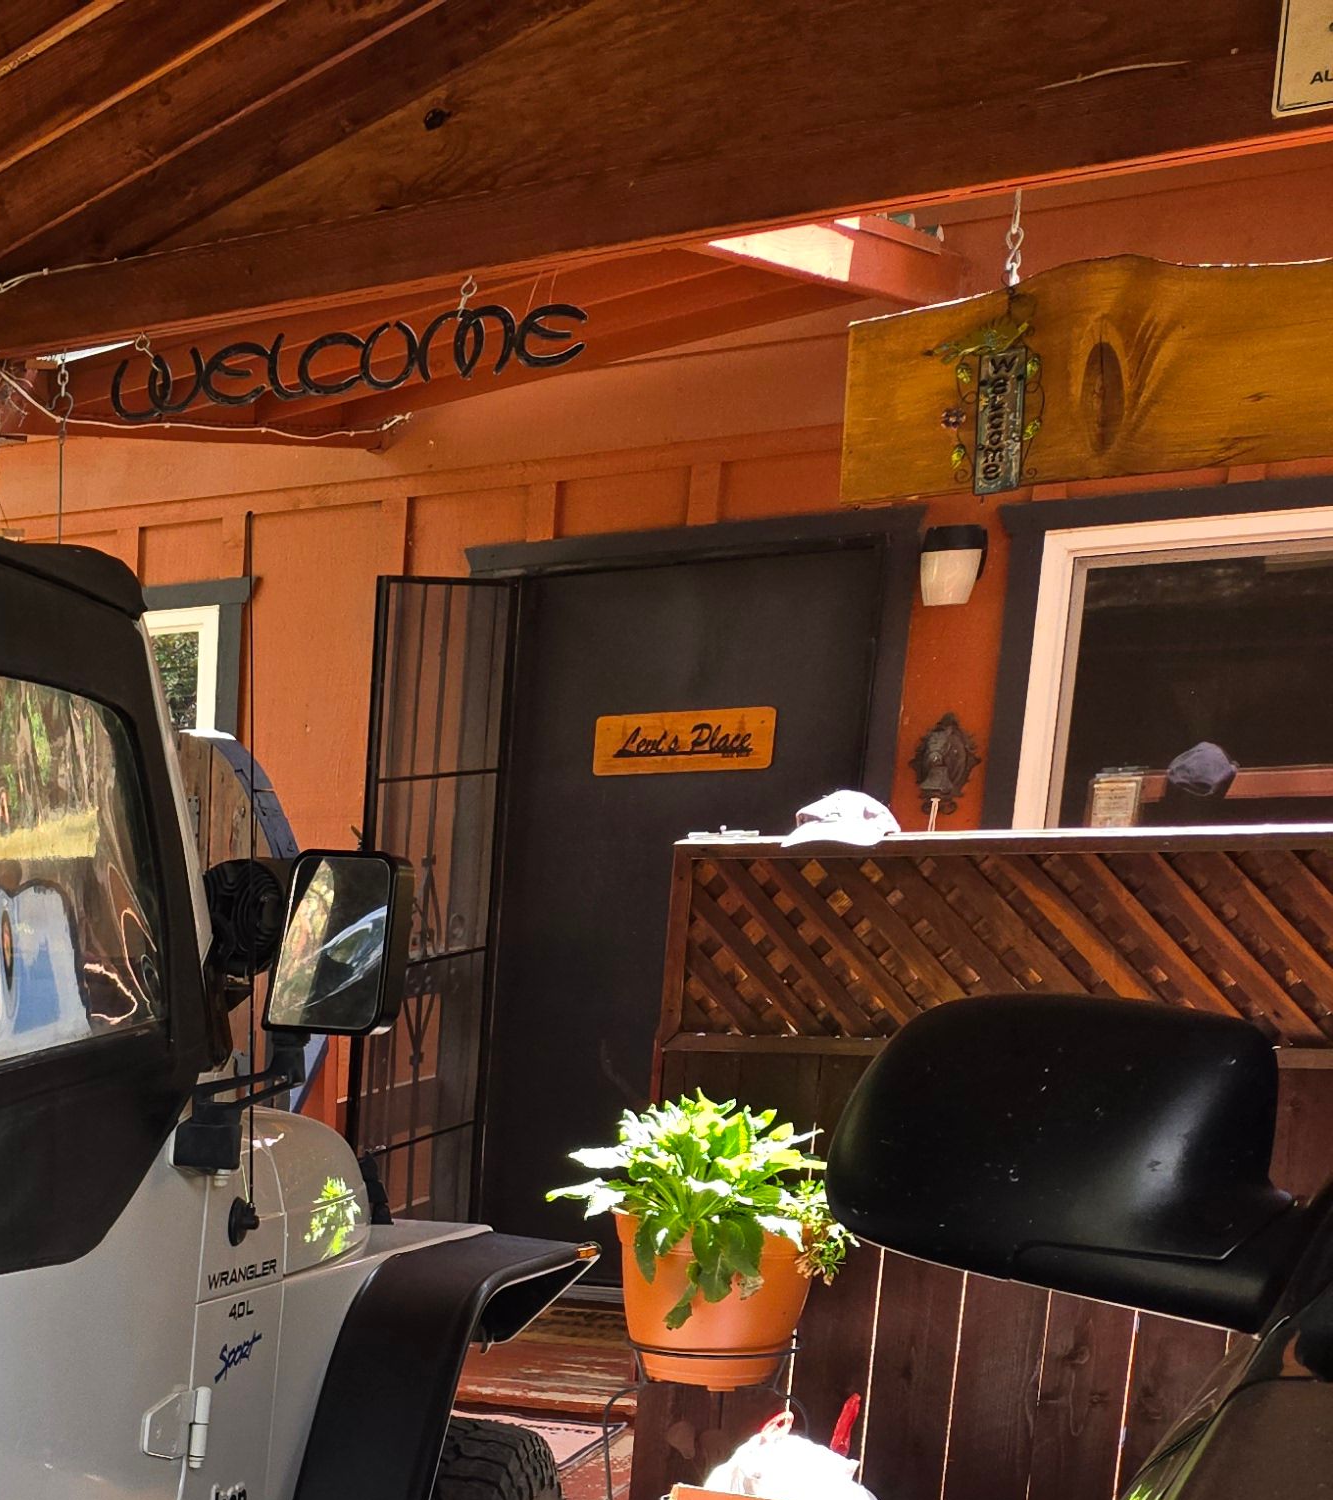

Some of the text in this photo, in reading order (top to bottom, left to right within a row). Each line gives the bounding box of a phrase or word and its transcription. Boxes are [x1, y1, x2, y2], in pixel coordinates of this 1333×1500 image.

[111, 304, 588, 421] WELCOME
[690, 723, 753, 754] Place
[208, 1259, 277, 1290] WRANGLER
[214, 1329, 262, 1384] Sport
